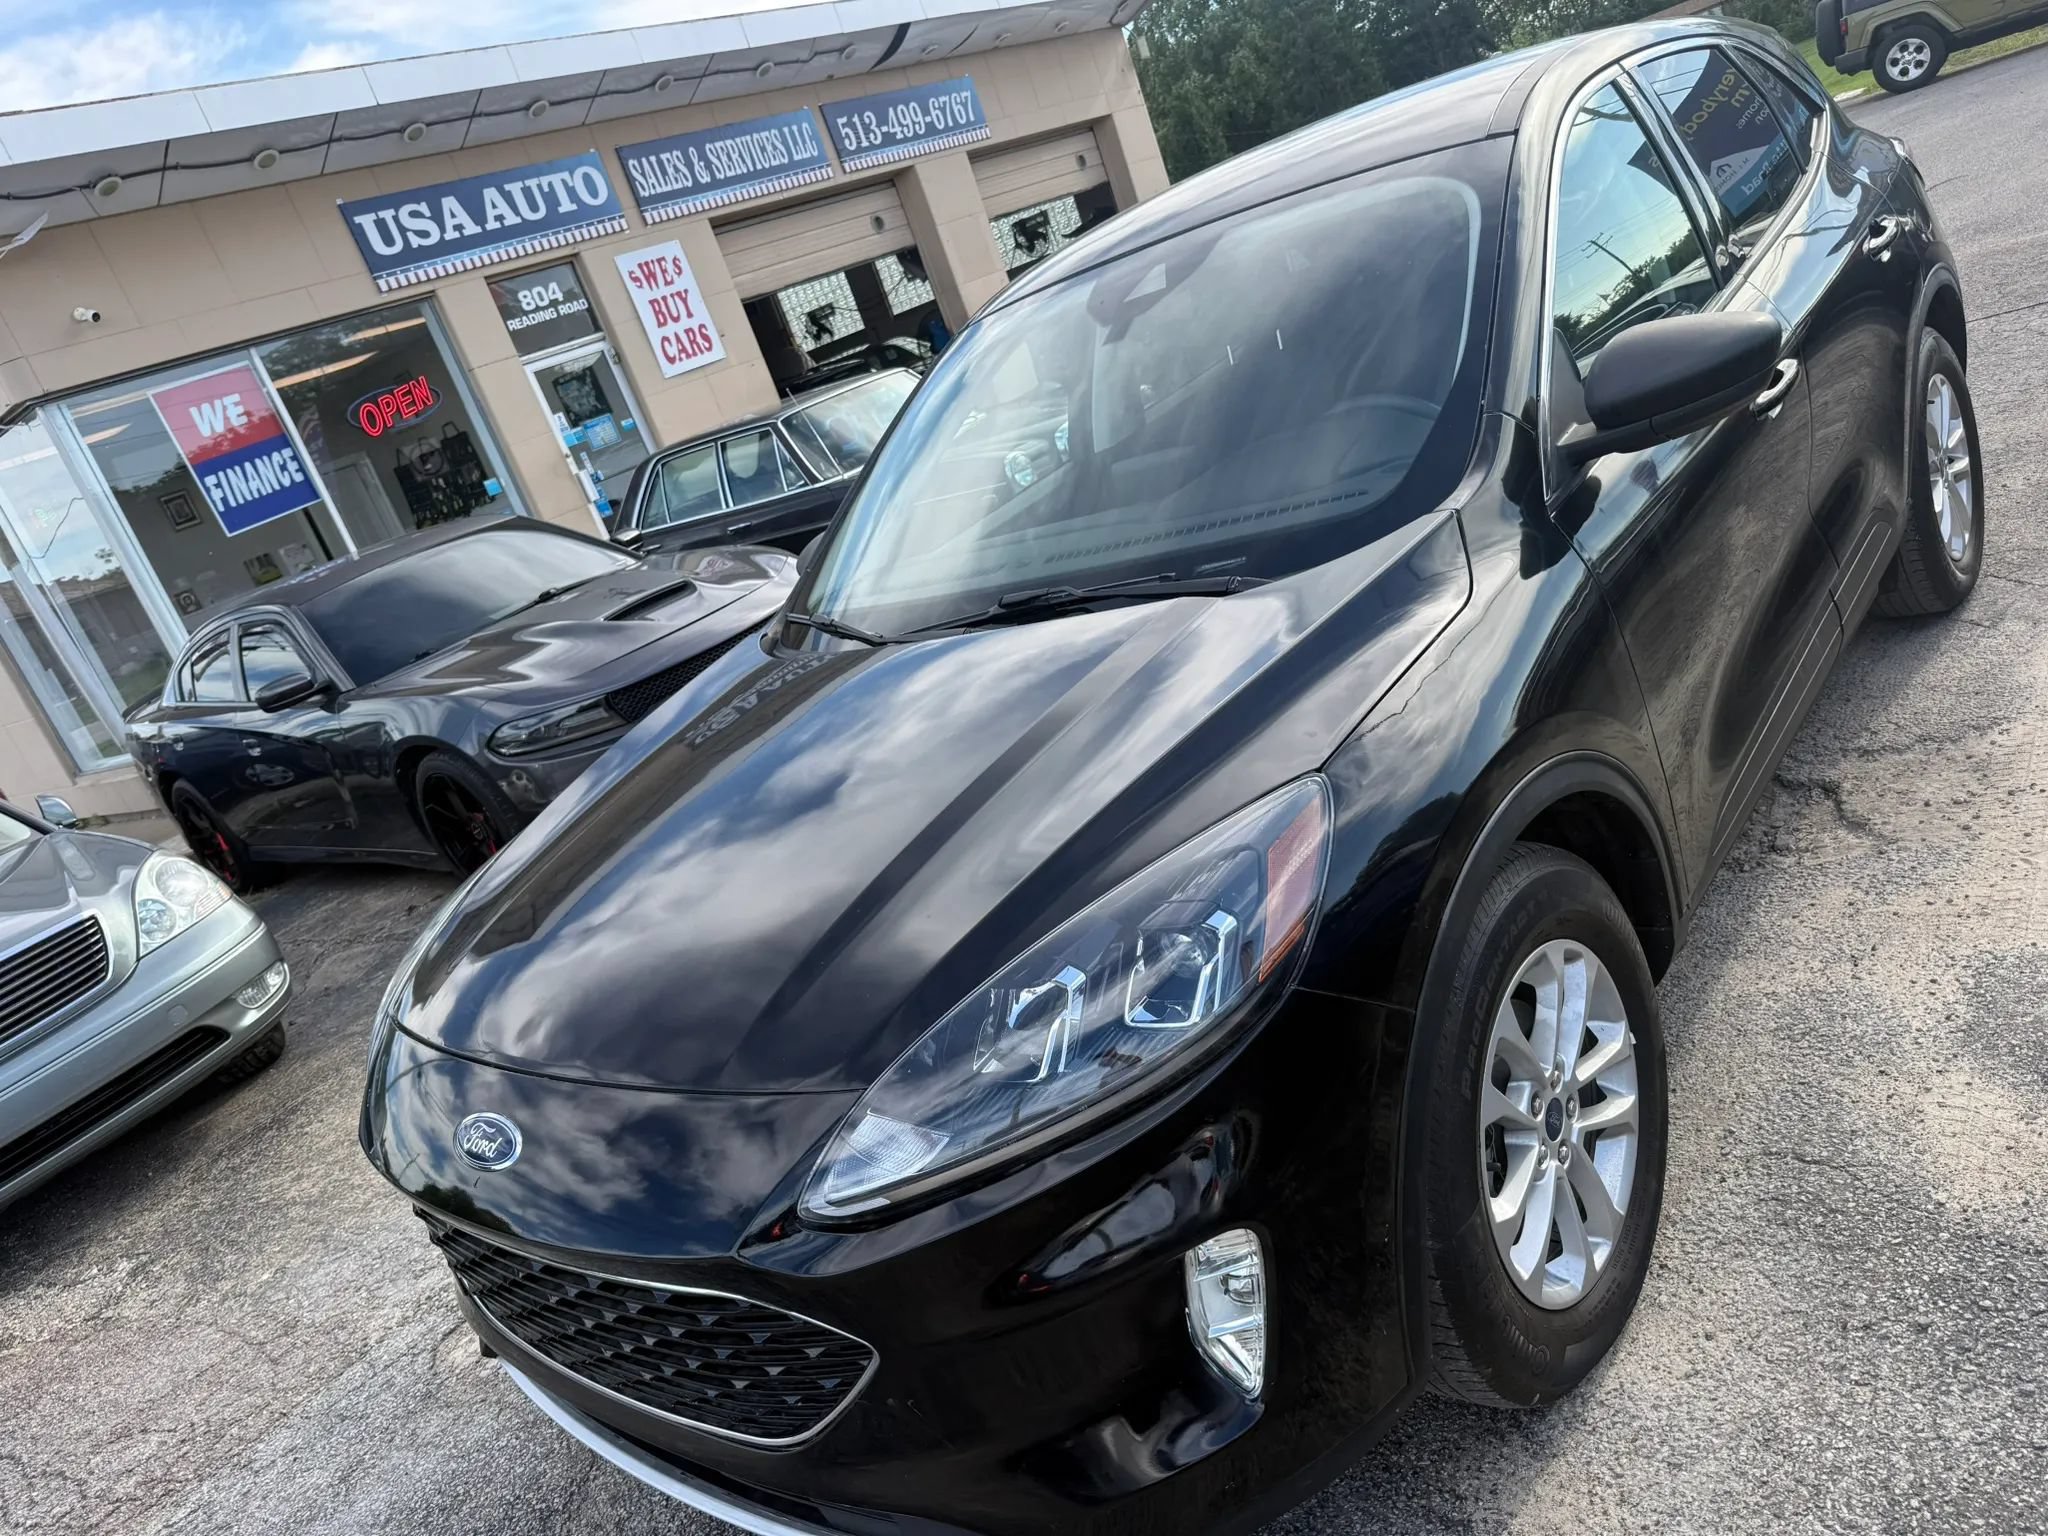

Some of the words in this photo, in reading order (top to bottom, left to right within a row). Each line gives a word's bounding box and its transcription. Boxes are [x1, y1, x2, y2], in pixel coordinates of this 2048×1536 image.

[836, 90, 976, 151] 513-499-6767
[628, 151, 693, 197] SALES
[688, 147, 711, 183] &
[707, 127, 787, 181] SERVICES
[786, 122, 818, 161] LLC
[353, 196, 483, 256] USA
[482, 165, 609, 232] AUTO
[506, 307, 557, 332] READING
[558, 298, 589, 318] ROAD
[517, 281, 564, 312] 804
[648, 288, 694, 329] BUY
[660, 323, 713, 365] CARS
[189, 393, 249, 438] WE
[359, 375, 434, 438] OPEN
[203, 446, 305, 513] FINANCE
[463, 1122, 504, 1158] Ford
